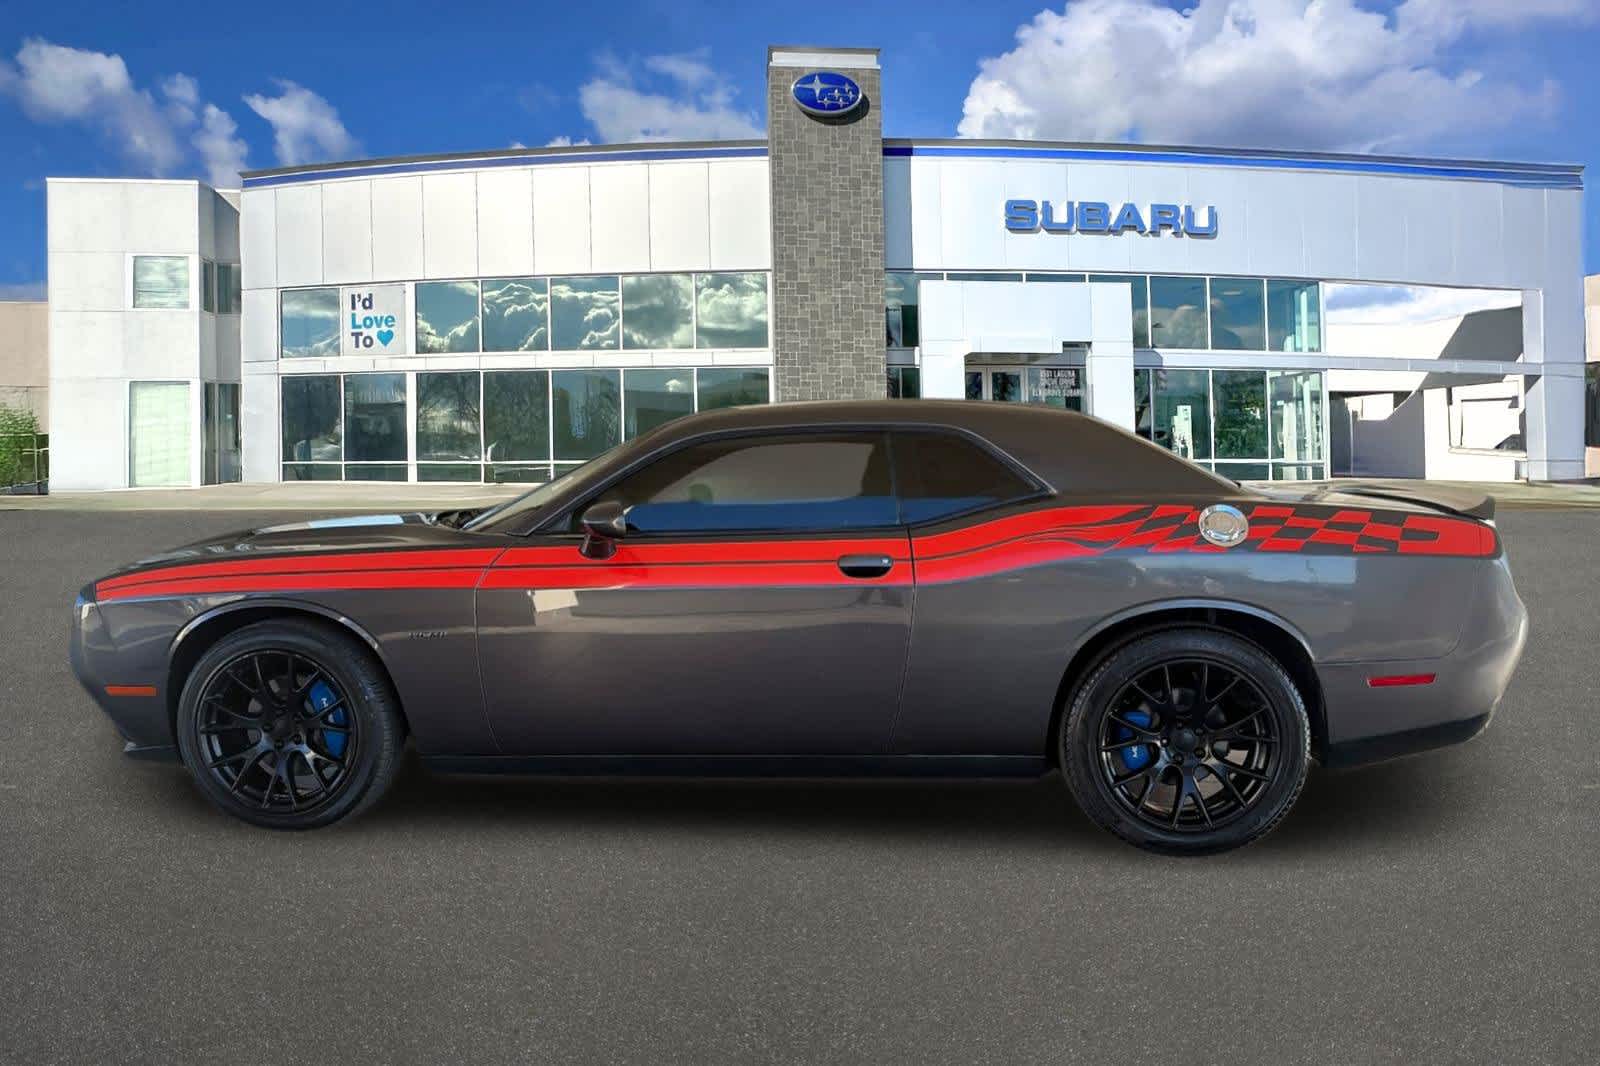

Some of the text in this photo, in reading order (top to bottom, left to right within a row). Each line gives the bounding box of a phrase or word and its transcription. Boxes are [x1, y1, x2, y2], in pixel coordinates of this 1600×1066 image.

[1005, 199, 1218, 238] SUBARU
[350, 293, 373, 310] I'd
[351, 312, 396, 330] Love
[350, 331, 374, 349] To
